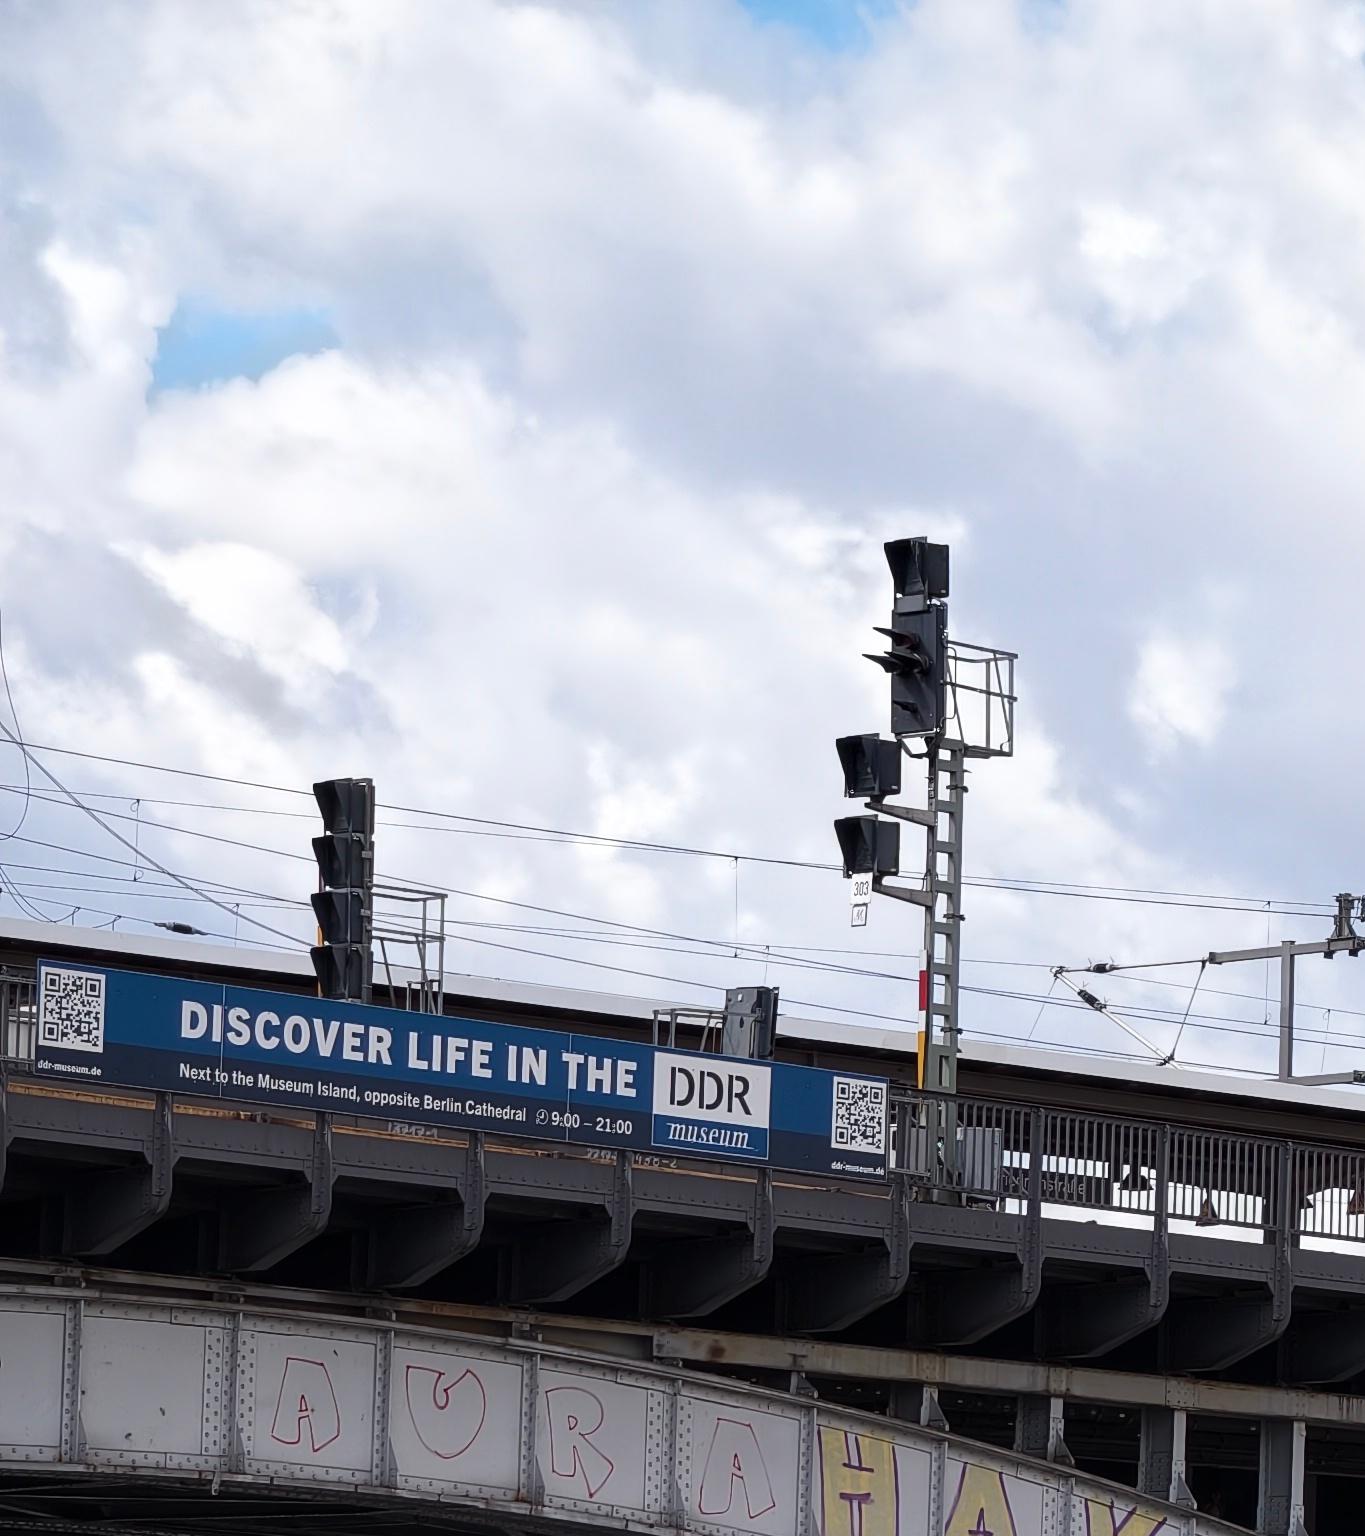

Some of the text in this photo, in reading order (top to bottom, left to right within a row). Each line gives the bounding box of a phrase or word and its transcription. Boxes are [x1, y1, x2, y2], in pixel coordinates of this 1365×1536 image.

[854, 881, 869, 896] 303
[181, 1000, 637, 1098] DISCOVER LIFE IN THE
[37, 1060, 102, 1076] ddr-museum.de
[179, 1063, 211, 1081] Next
[214, 1069, 229, 1083] to
[232, 1070, 254, 1088] the
[257, 1074, 314, 1096] Museum
[318, 1081, 361, 1103] Island,
[364, 1089, 420, 1109] opposite
[424, 1095, 462, 1113] Berlin
[465, 1100, 526, 1122] Cathedral
[551, 1111, 580, 1129] 9:00
[596, 1116, 633, 1135] 21:00
[669, 1066, 752, 1116] DDR
[666, 1122, 758, 1152] museum
[831, 1161, 884, 1176] ddr-museum.de
